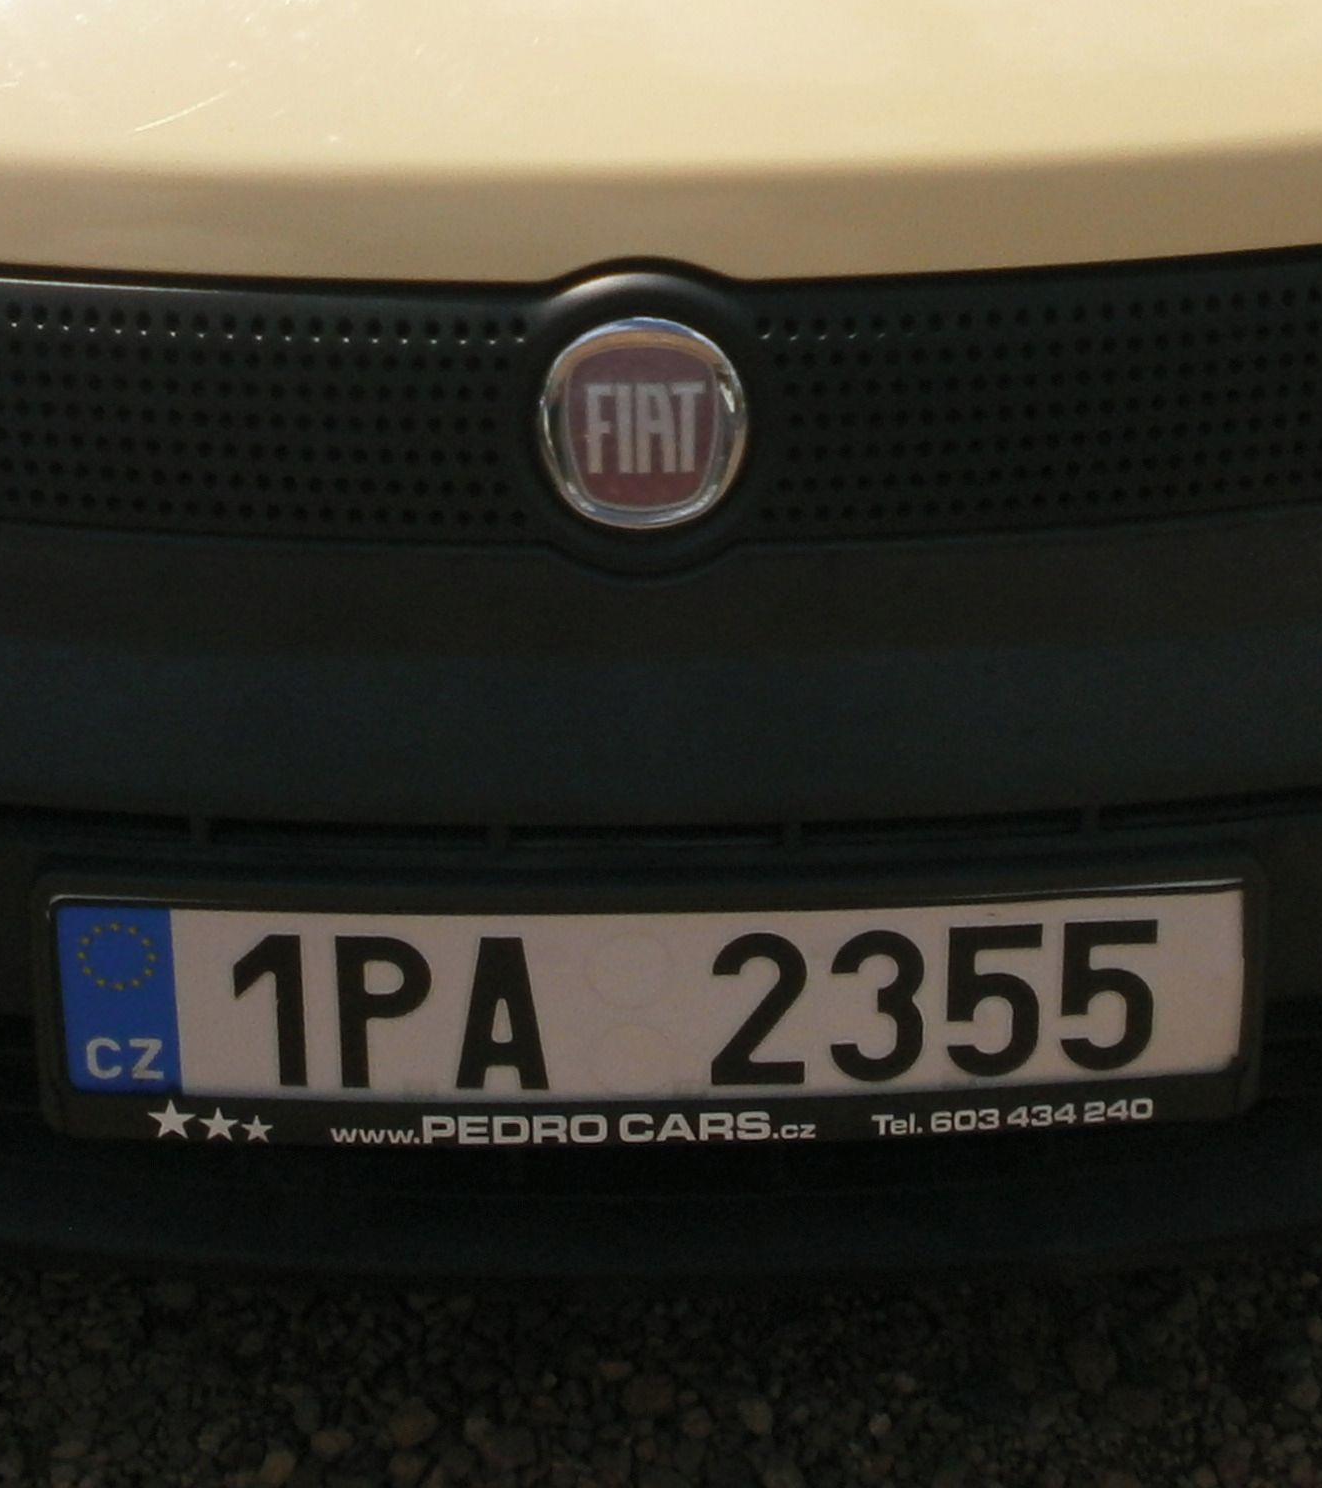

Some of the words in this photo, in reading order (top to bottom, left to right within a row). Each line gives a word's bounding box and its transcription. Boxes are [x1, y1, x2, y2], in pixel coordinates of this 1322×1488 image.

[585, 382, 705, 474] FIAT
[233, 934, 549, 1089] 1PA
[711, 919, 1158, 1085] 2355
[86, 1038, 164, 1080] CZ
[872, 1114, 923, 1136] Tel.
[930, 1109, 1000, 1134] 603
[1006, 1103, 1077, 1129] 434
[1082, 1098, 1154, 1122] 240
